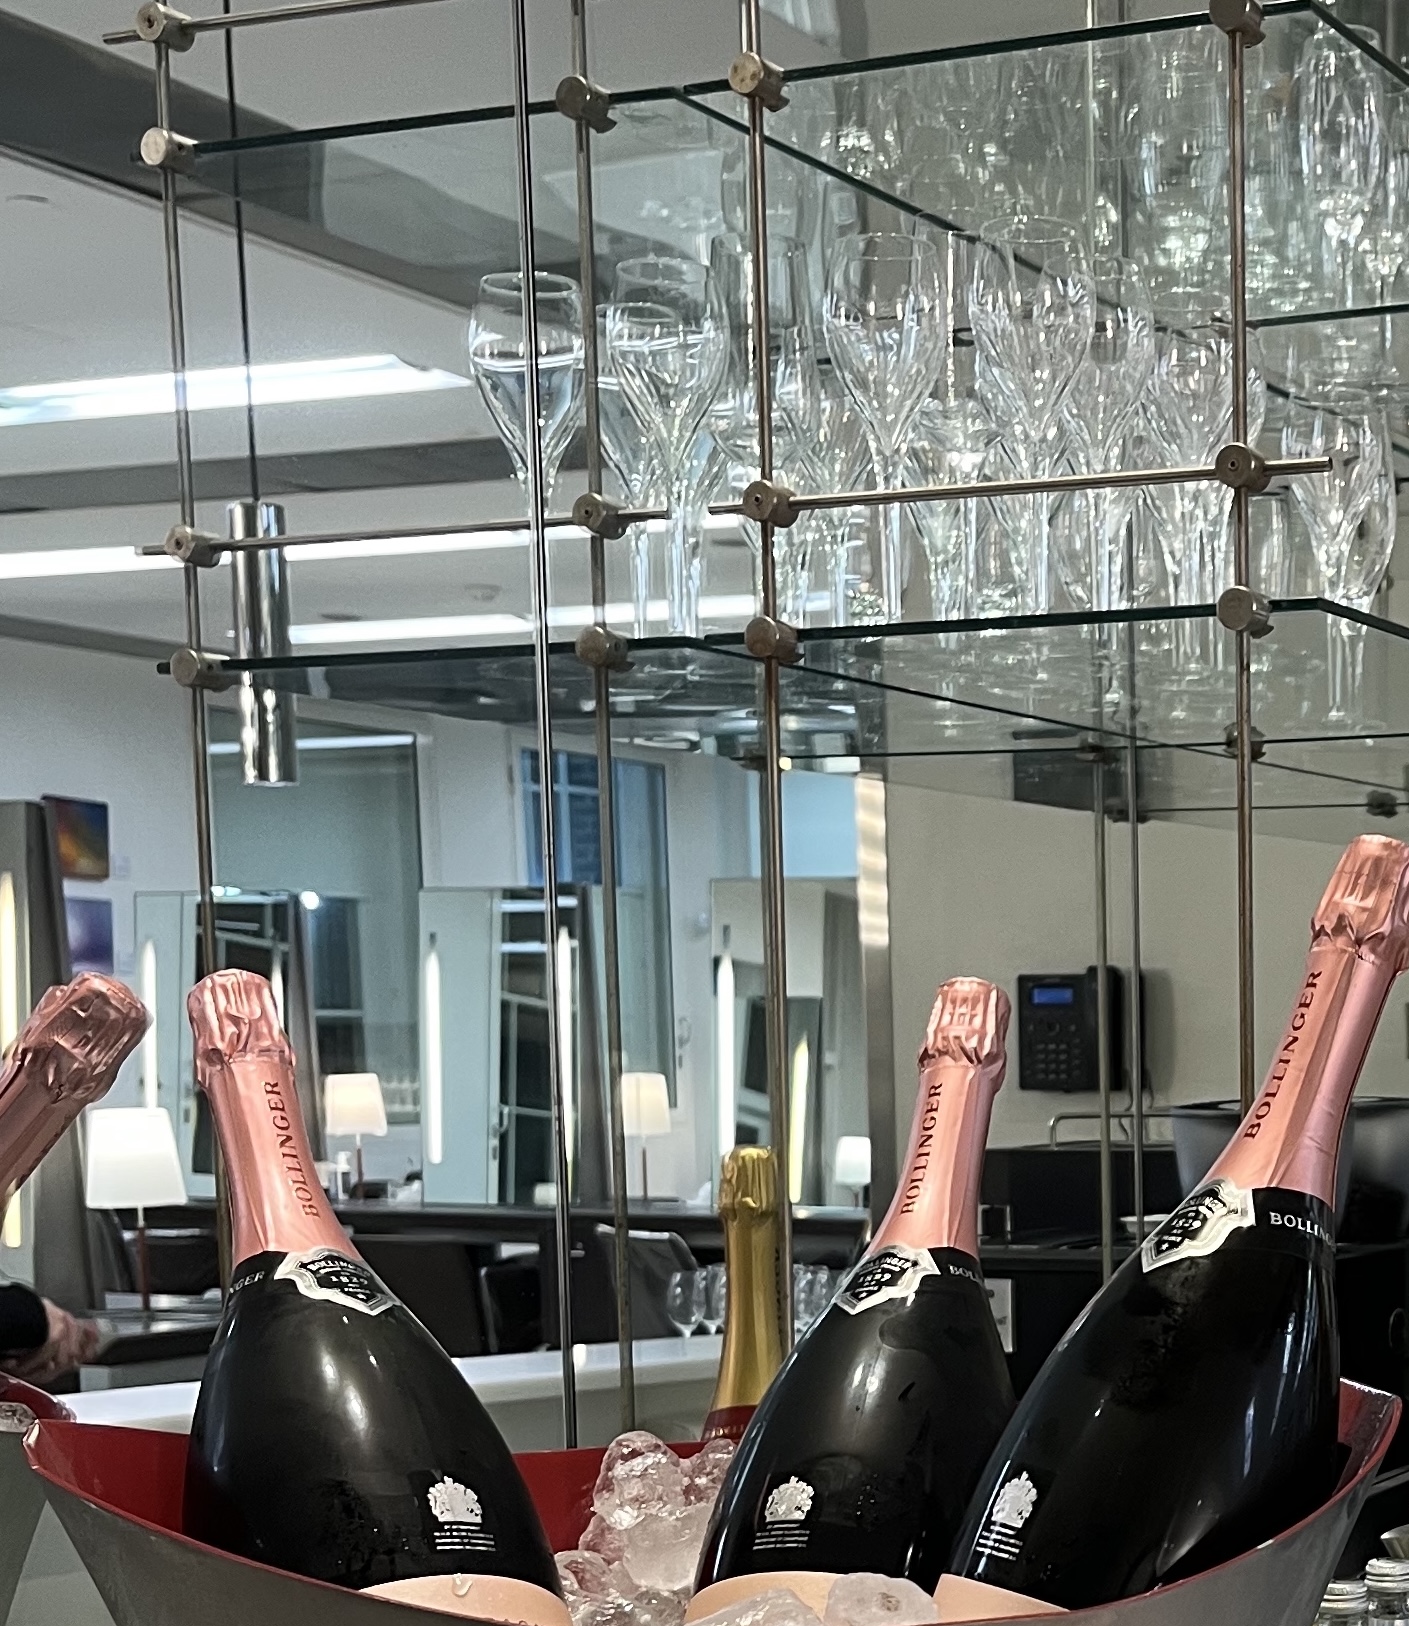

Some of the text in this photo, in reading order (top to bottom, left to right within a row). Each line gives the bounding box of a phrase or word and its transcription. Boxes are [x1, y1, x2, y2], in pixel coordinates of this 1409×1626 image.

[1243, 970, 1322, 1140] BOLLINGER
[262, 1080, 321, 1218] BOLLINGER
[900, 1081, 944, 1215] BOLLINGER
